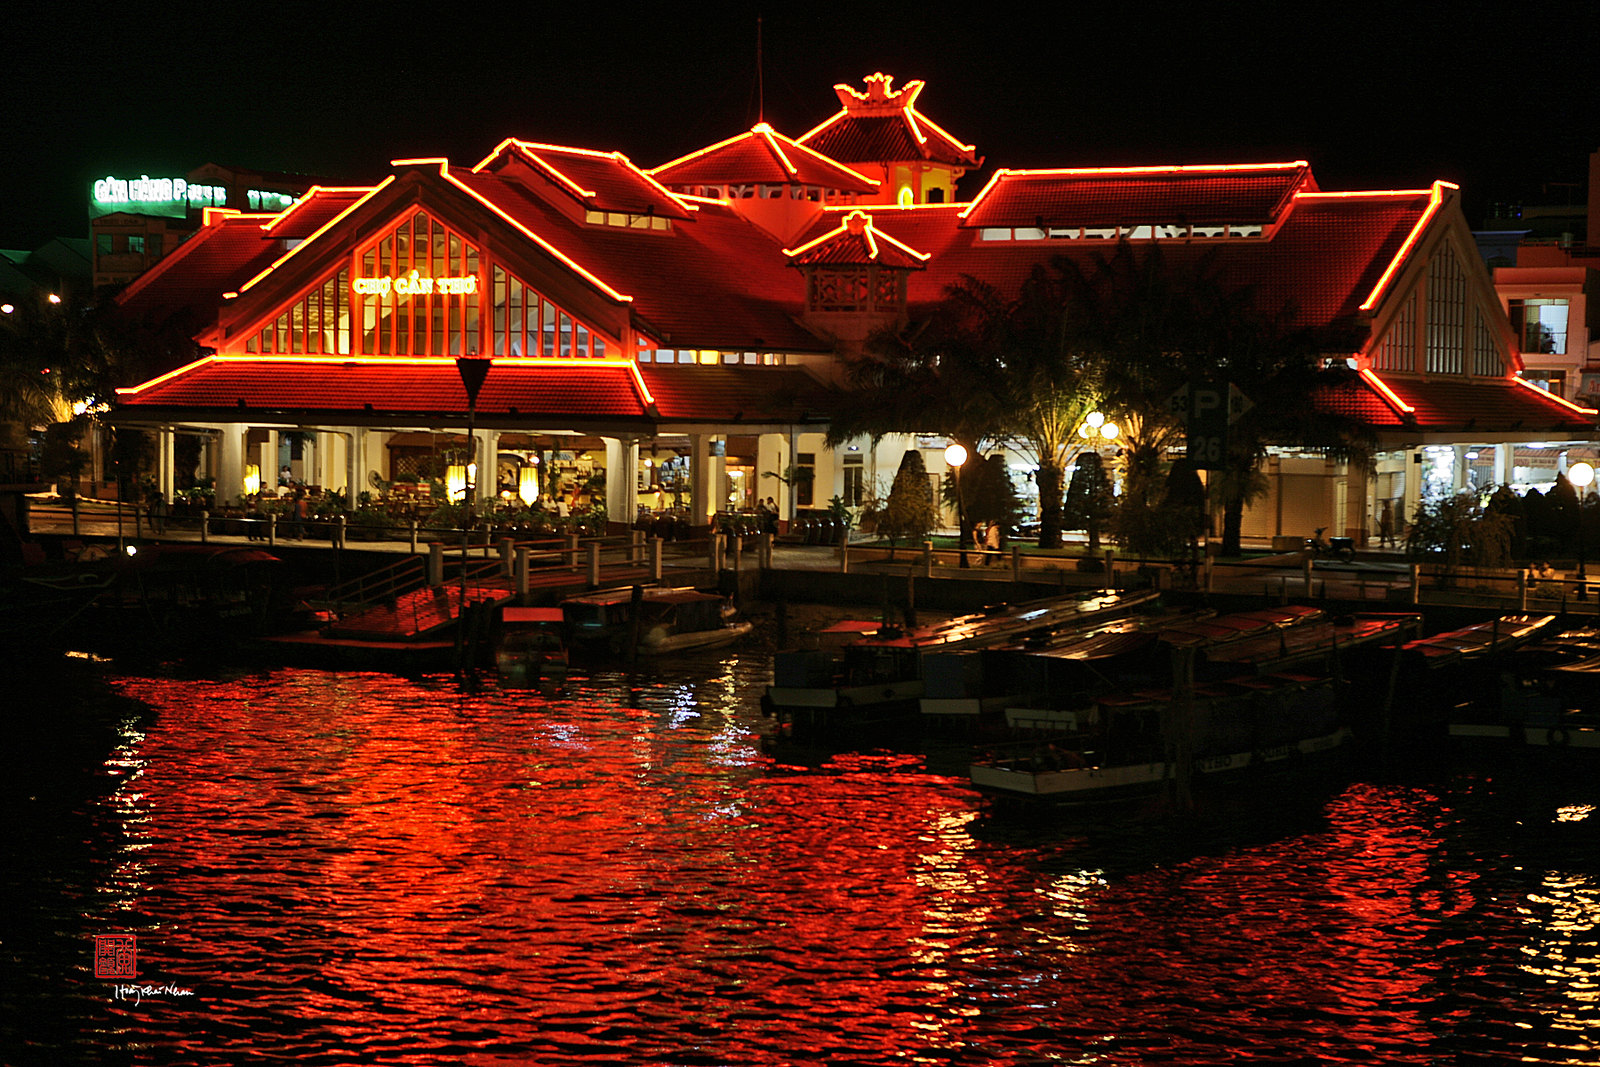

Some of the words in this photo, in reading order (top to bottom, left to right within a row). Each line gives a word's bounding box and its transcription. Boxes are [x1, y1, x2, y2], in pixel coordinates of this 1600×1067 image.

[352, 275, 392, 298] CHỢ
[436, 274, 477, 295] THƠ
[1194, 390, 1221, 418] P
[1193, 435, 1221, 462] 26
